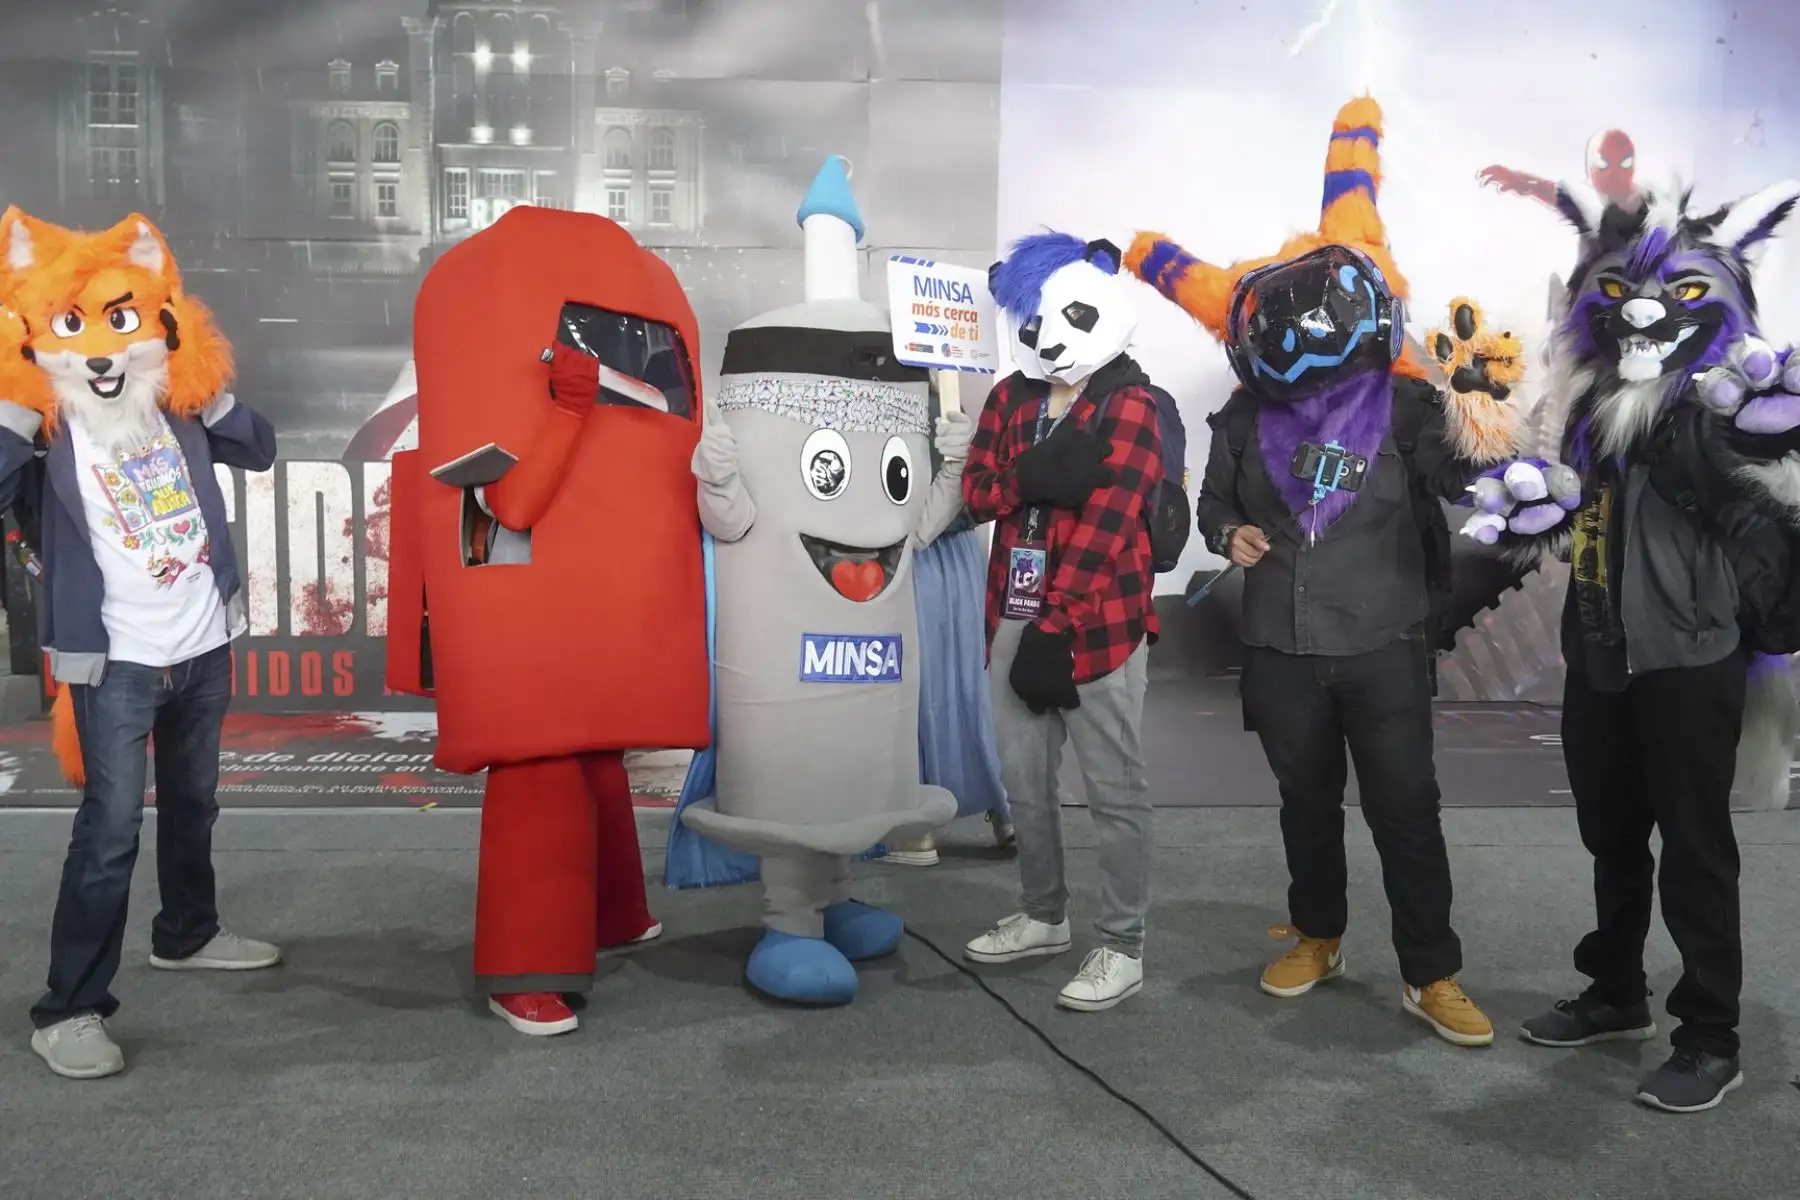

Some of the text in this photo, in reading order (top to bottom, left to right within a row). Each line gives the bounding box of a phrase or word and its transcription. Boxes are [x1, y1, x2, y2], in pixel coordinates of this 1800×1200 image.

[913, 274, 974, 305] MINSA
[911, 300, 978, 324] más cerca
[950, 322, 979, 341] de ti
[804, 640, 900, 677] MINSA
[243, 751, 295, 763] de
[395, 765, 427, 773] en
